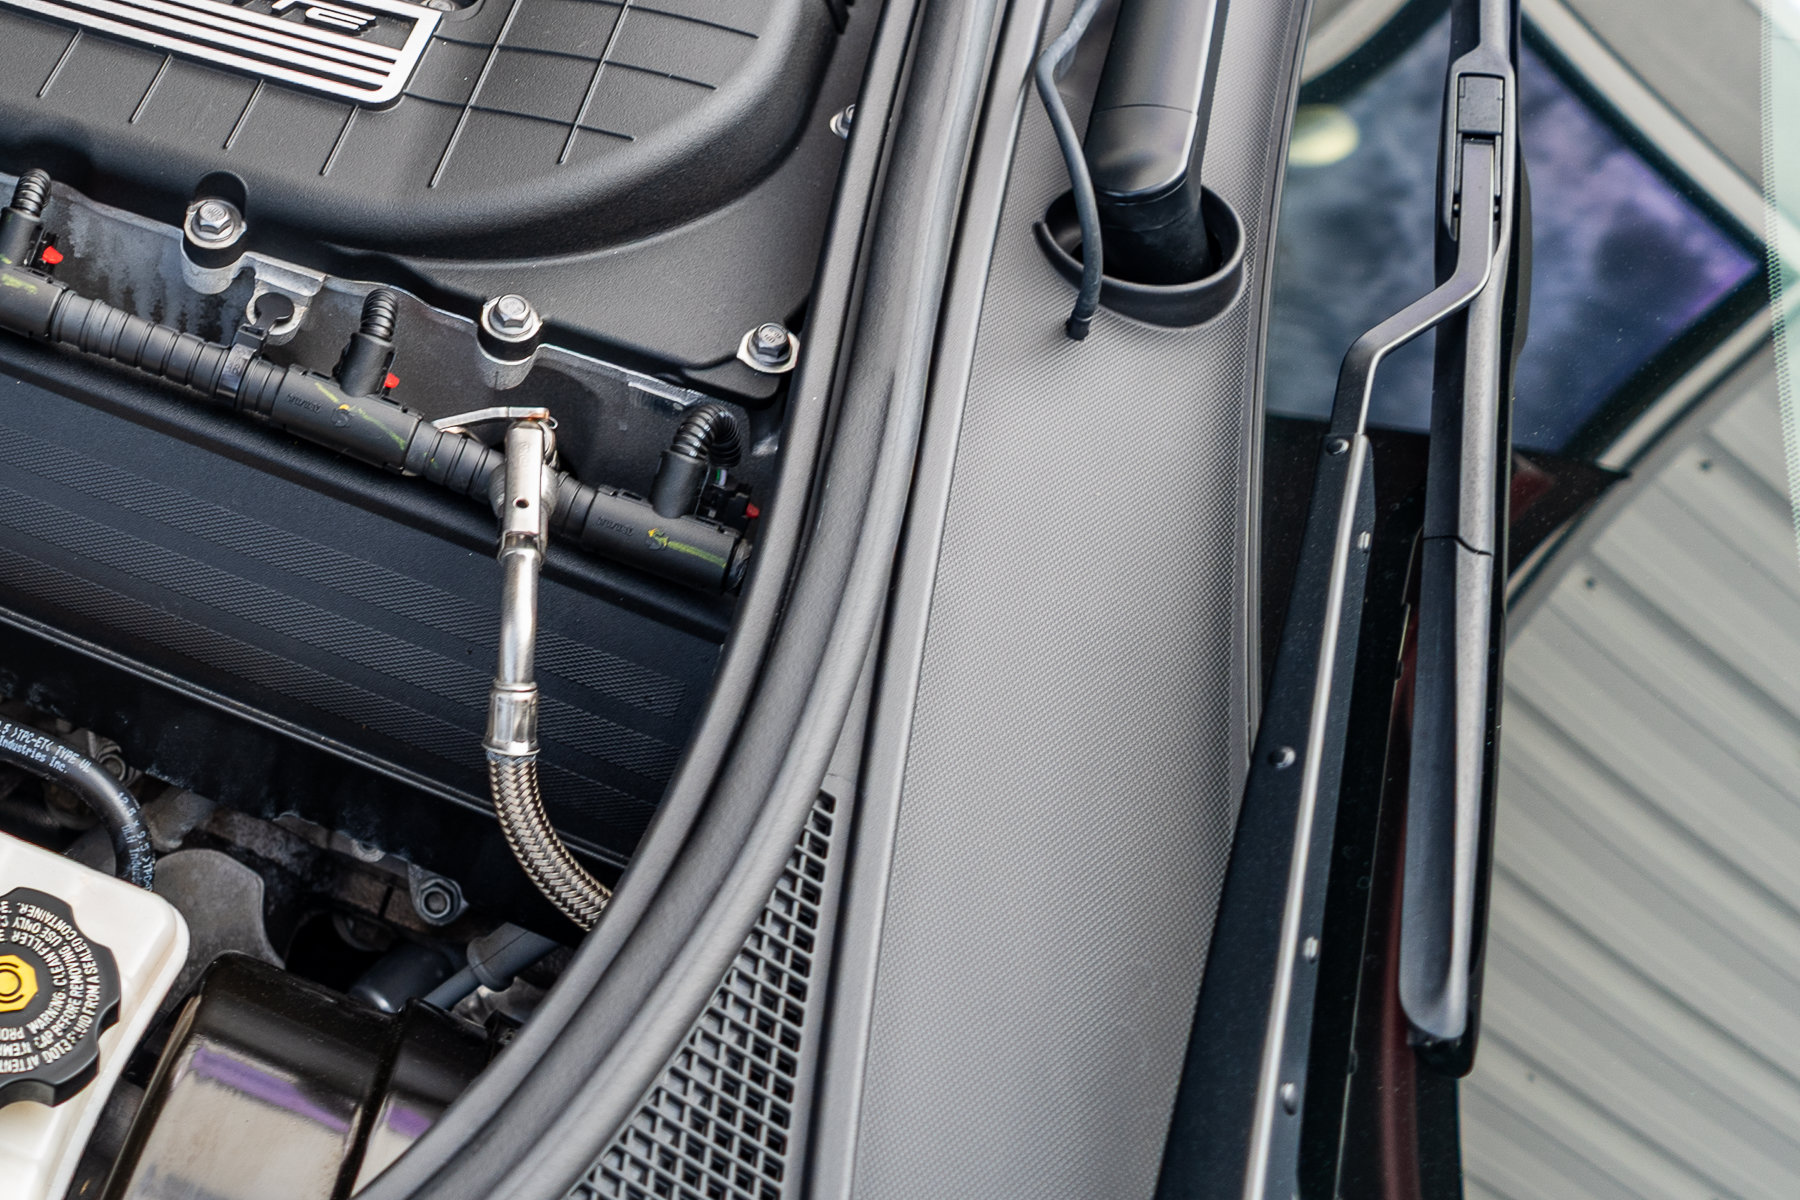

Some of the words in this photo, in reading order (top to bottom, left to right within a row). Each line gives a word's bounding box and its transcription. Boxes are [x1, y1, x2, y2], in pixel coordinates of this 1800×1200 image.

[48, 755, 68, 774] Inc.
[54, 745, 80, 765] TYPE
[12, 916, 42, 934] ONLY
[16, 902, 78, 941] CONTAINER.
[11, 930, 51, 956] FILLER
[39, 926, 63, 948] USE
[70, 936, 99, 975] SEALED
[42, 951, 68, 988] CLEAN
[86, 975, 100, 984] A
[82, 984, 100, 1016] FROM
[49, 997, 82, 1037] BEFORE
[66, 1014, 93, 1045] FLUID
[33, 1029, 54, 1049] CAP
[41, 1038, 73, 1064] DOT3
